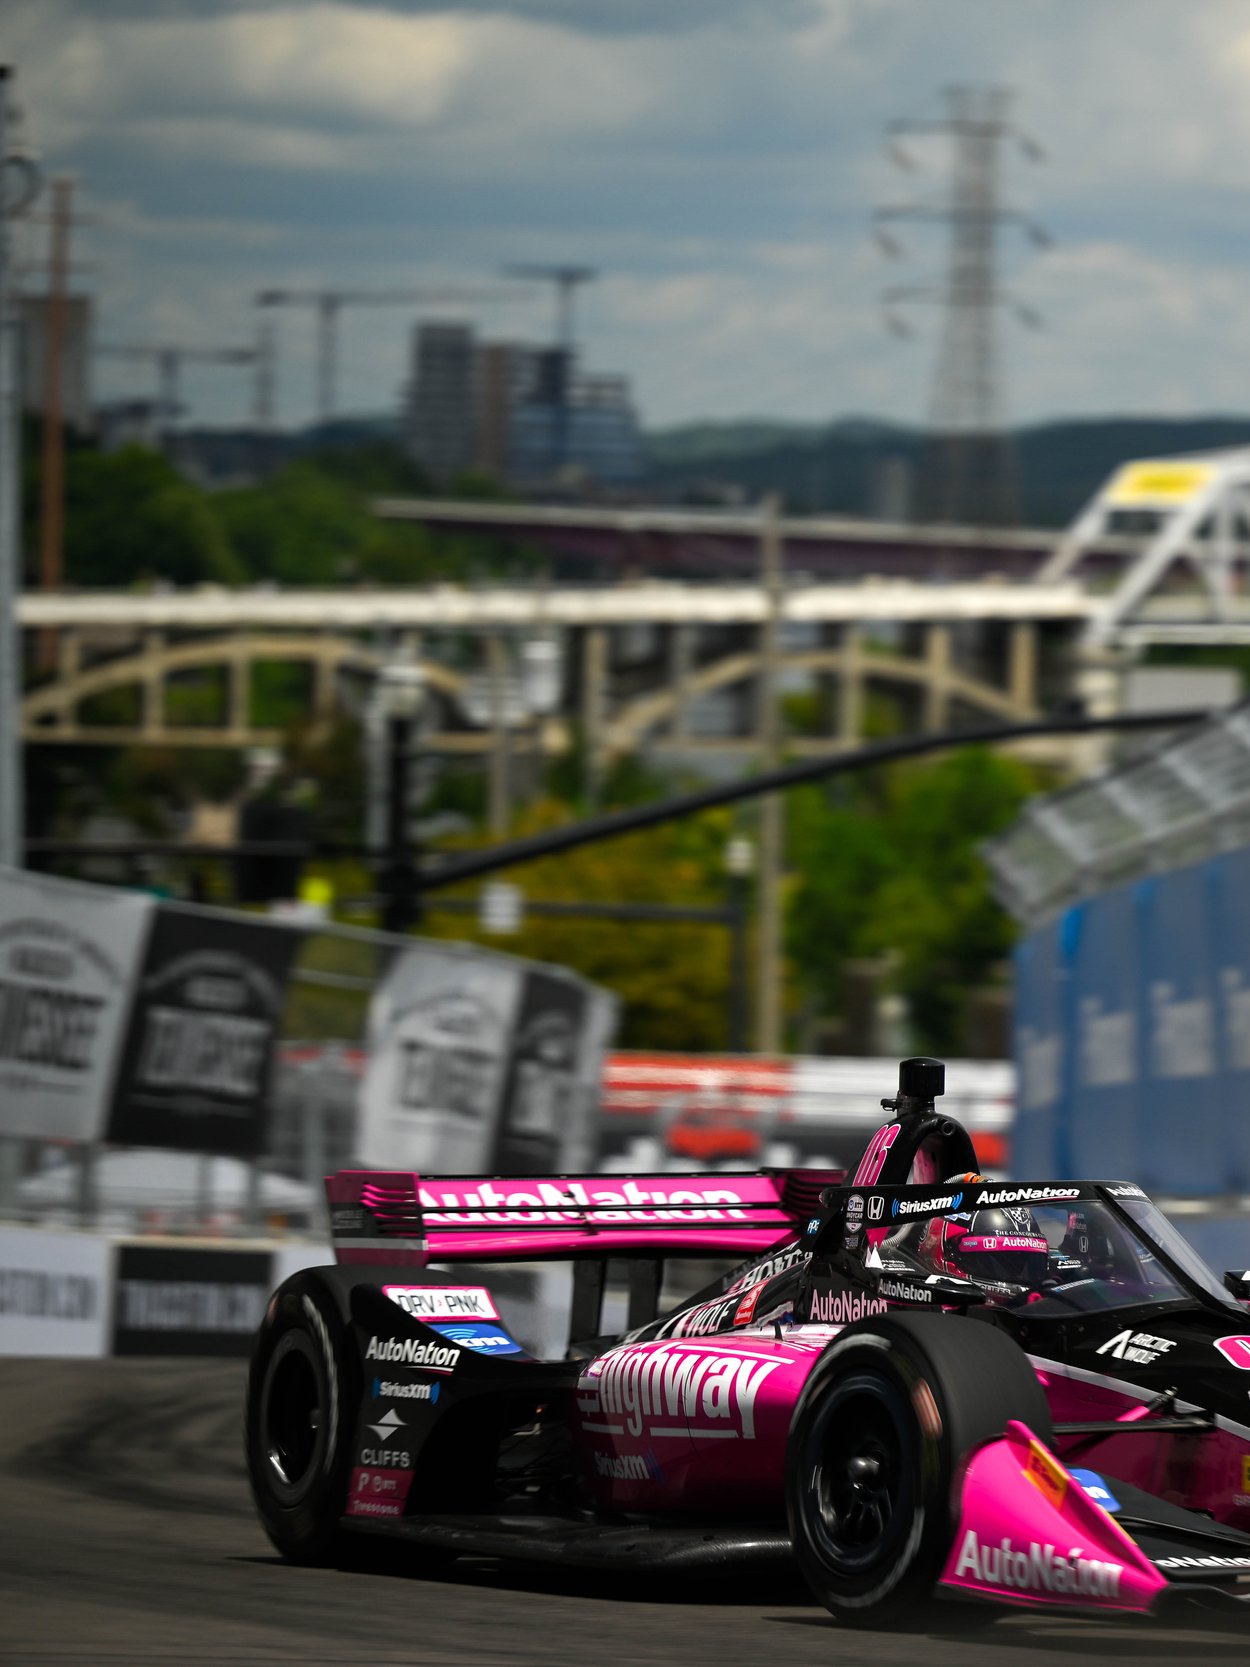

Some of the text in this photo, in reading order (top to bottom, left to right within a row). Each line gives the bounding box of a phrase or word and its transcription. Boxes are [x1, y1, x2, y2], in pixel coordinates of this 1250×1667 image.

[852, 1124, 901, 1187] 06
[976, 1187, 1081, 1204] AutoNation
[1002, 1237, 1048, 1249] AutoNation
[397, 1295, 486, 1314] DRV PNK
[878, 1278, 933, 1303] AutoNation
[810, 1288, 888, 1322] AutoNation
[365, 1336, 462, 1367] AutoNation
[600, 1342, 782, 1440] highway
[361, 1449, 411, 1467] CLIFFS
[954, 1530, 1125, 1598] AutoNation
